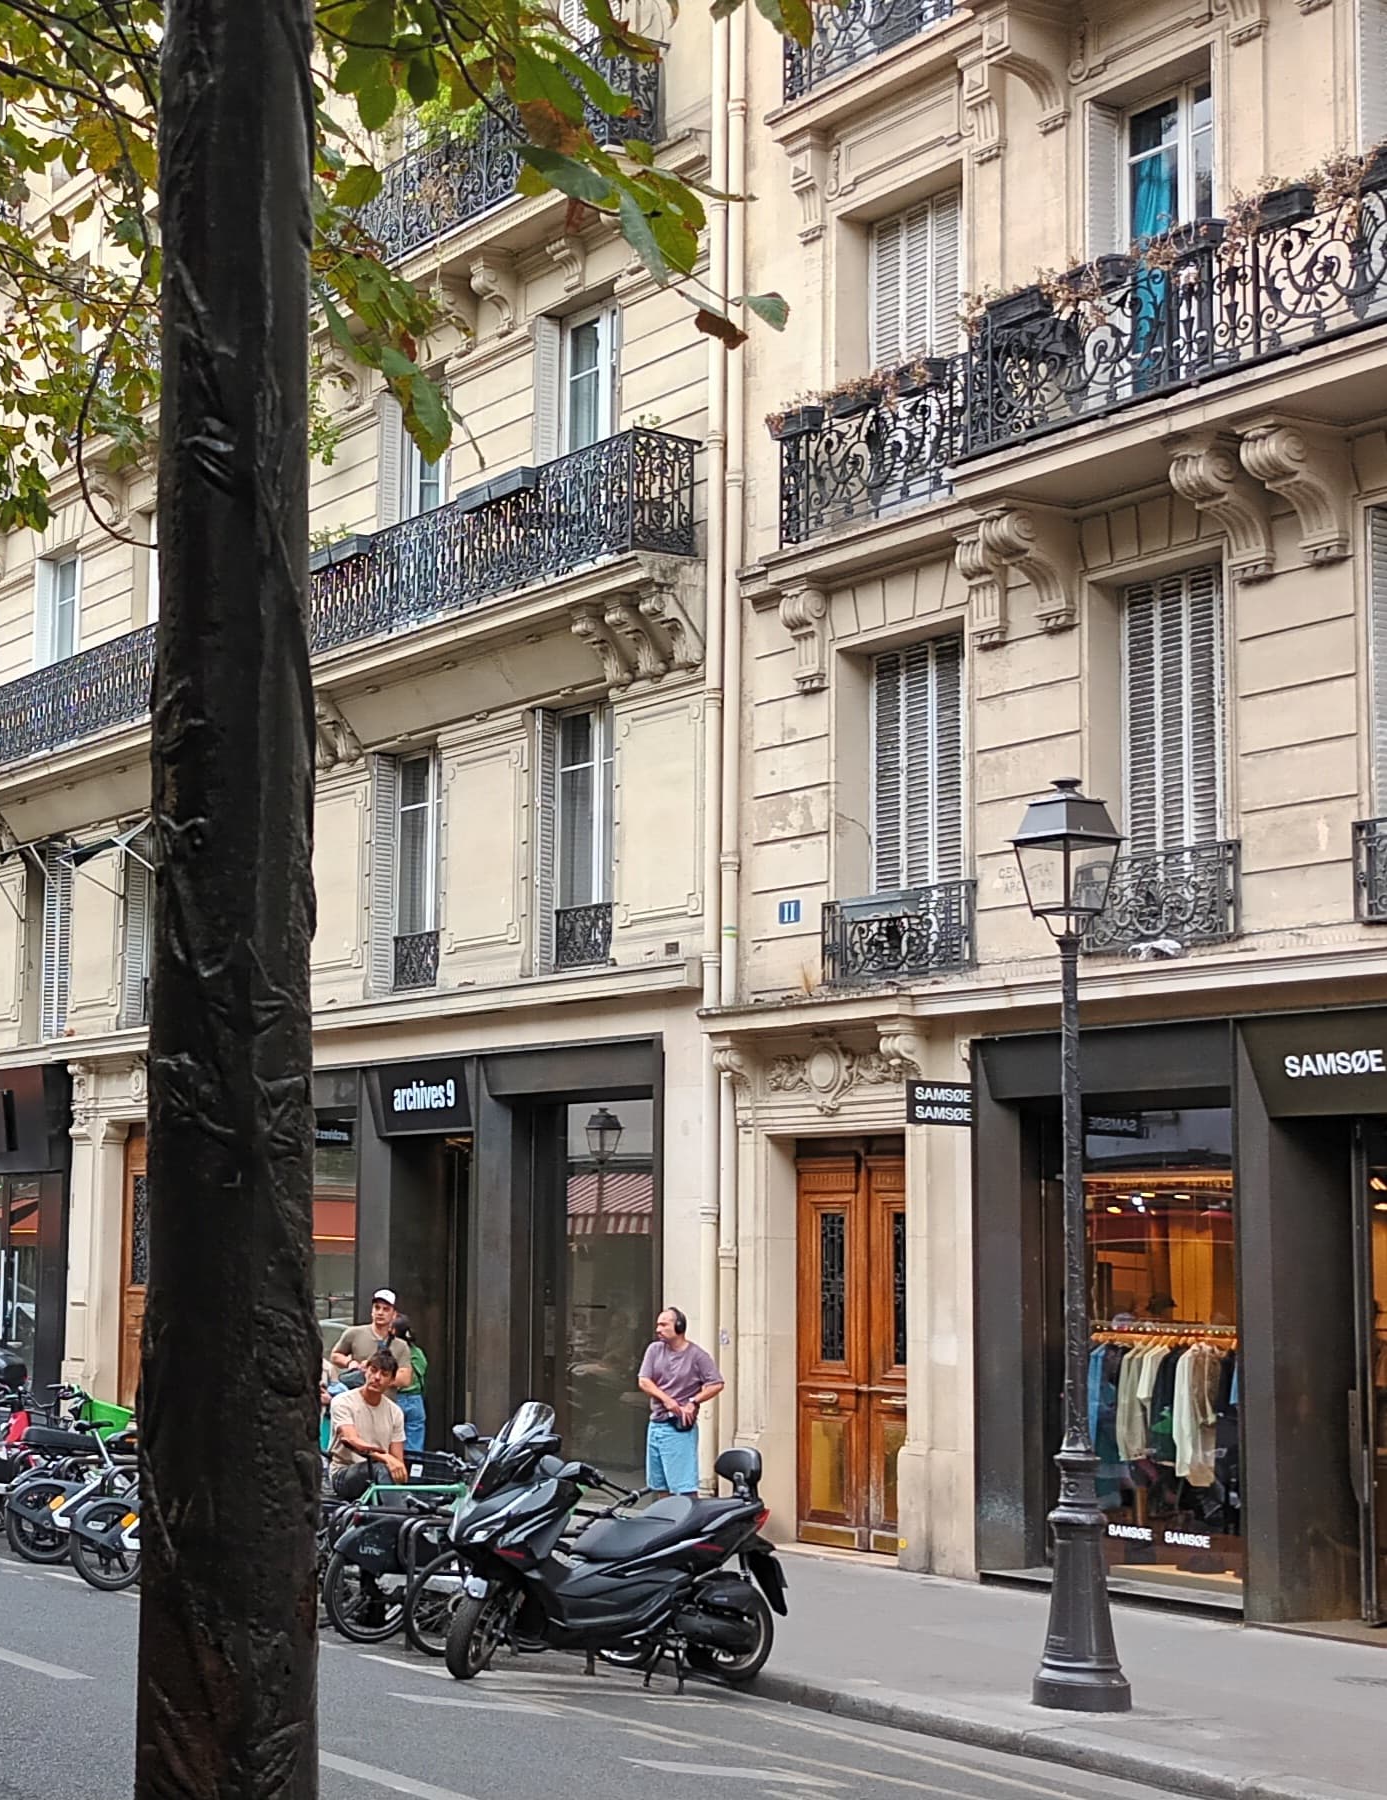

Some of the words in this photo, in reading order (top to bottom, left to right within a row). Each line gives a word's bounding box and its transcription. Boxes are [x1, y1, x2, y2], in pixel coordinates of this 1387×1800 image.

[1284, 1049, 1387, 1078] SAMSØE
[393, 1080, 445, 1111] archives
[446, 1079, 455, 1107] 9
[915, 1086, 972, 1103] SAMSØE
[915, 1105, 972, 1122] SAMSØE
